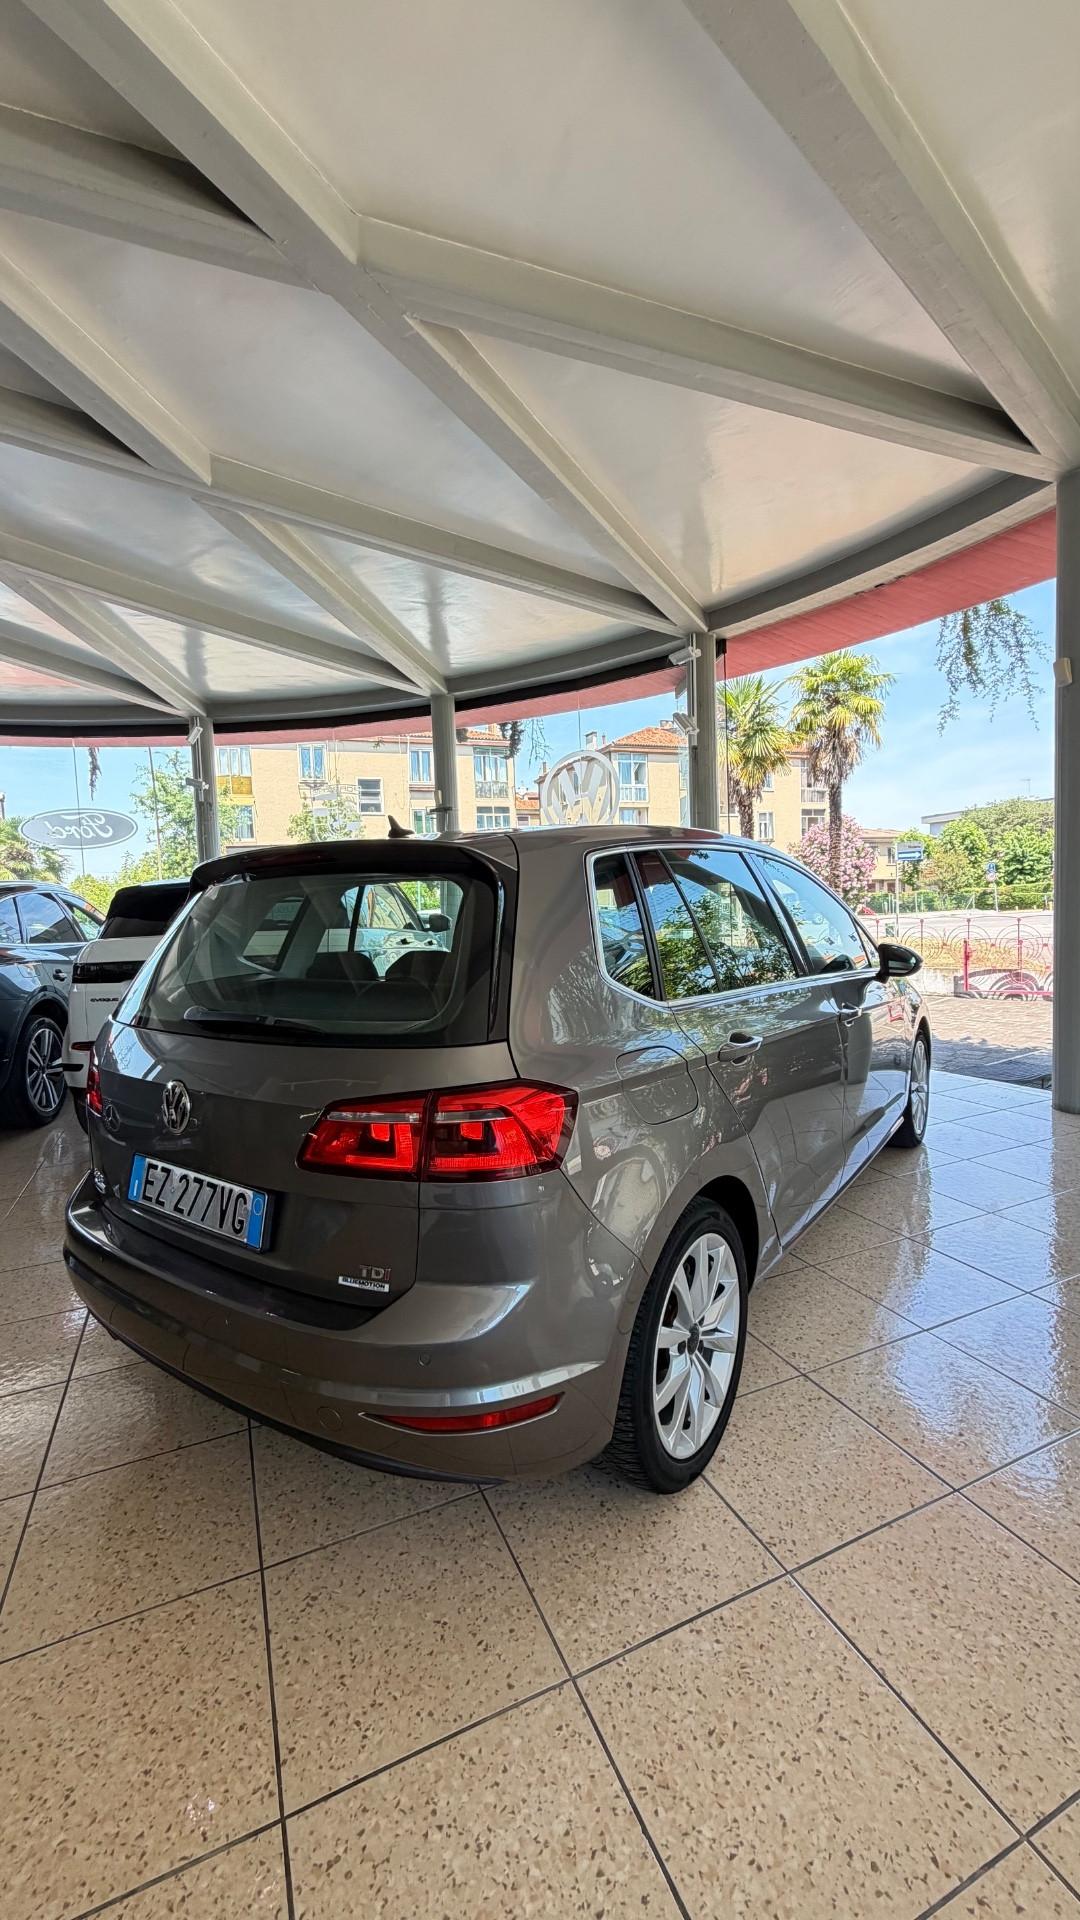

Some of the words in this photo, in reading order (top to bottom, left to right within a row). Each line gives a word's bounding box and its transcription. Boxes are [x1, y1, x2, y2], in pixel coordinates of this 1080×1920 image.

[141, 1162, 173, 1208] EZ
[173, 1173, 248, 1235] 277VG
[360, 1264, 392, 1281] TDI
